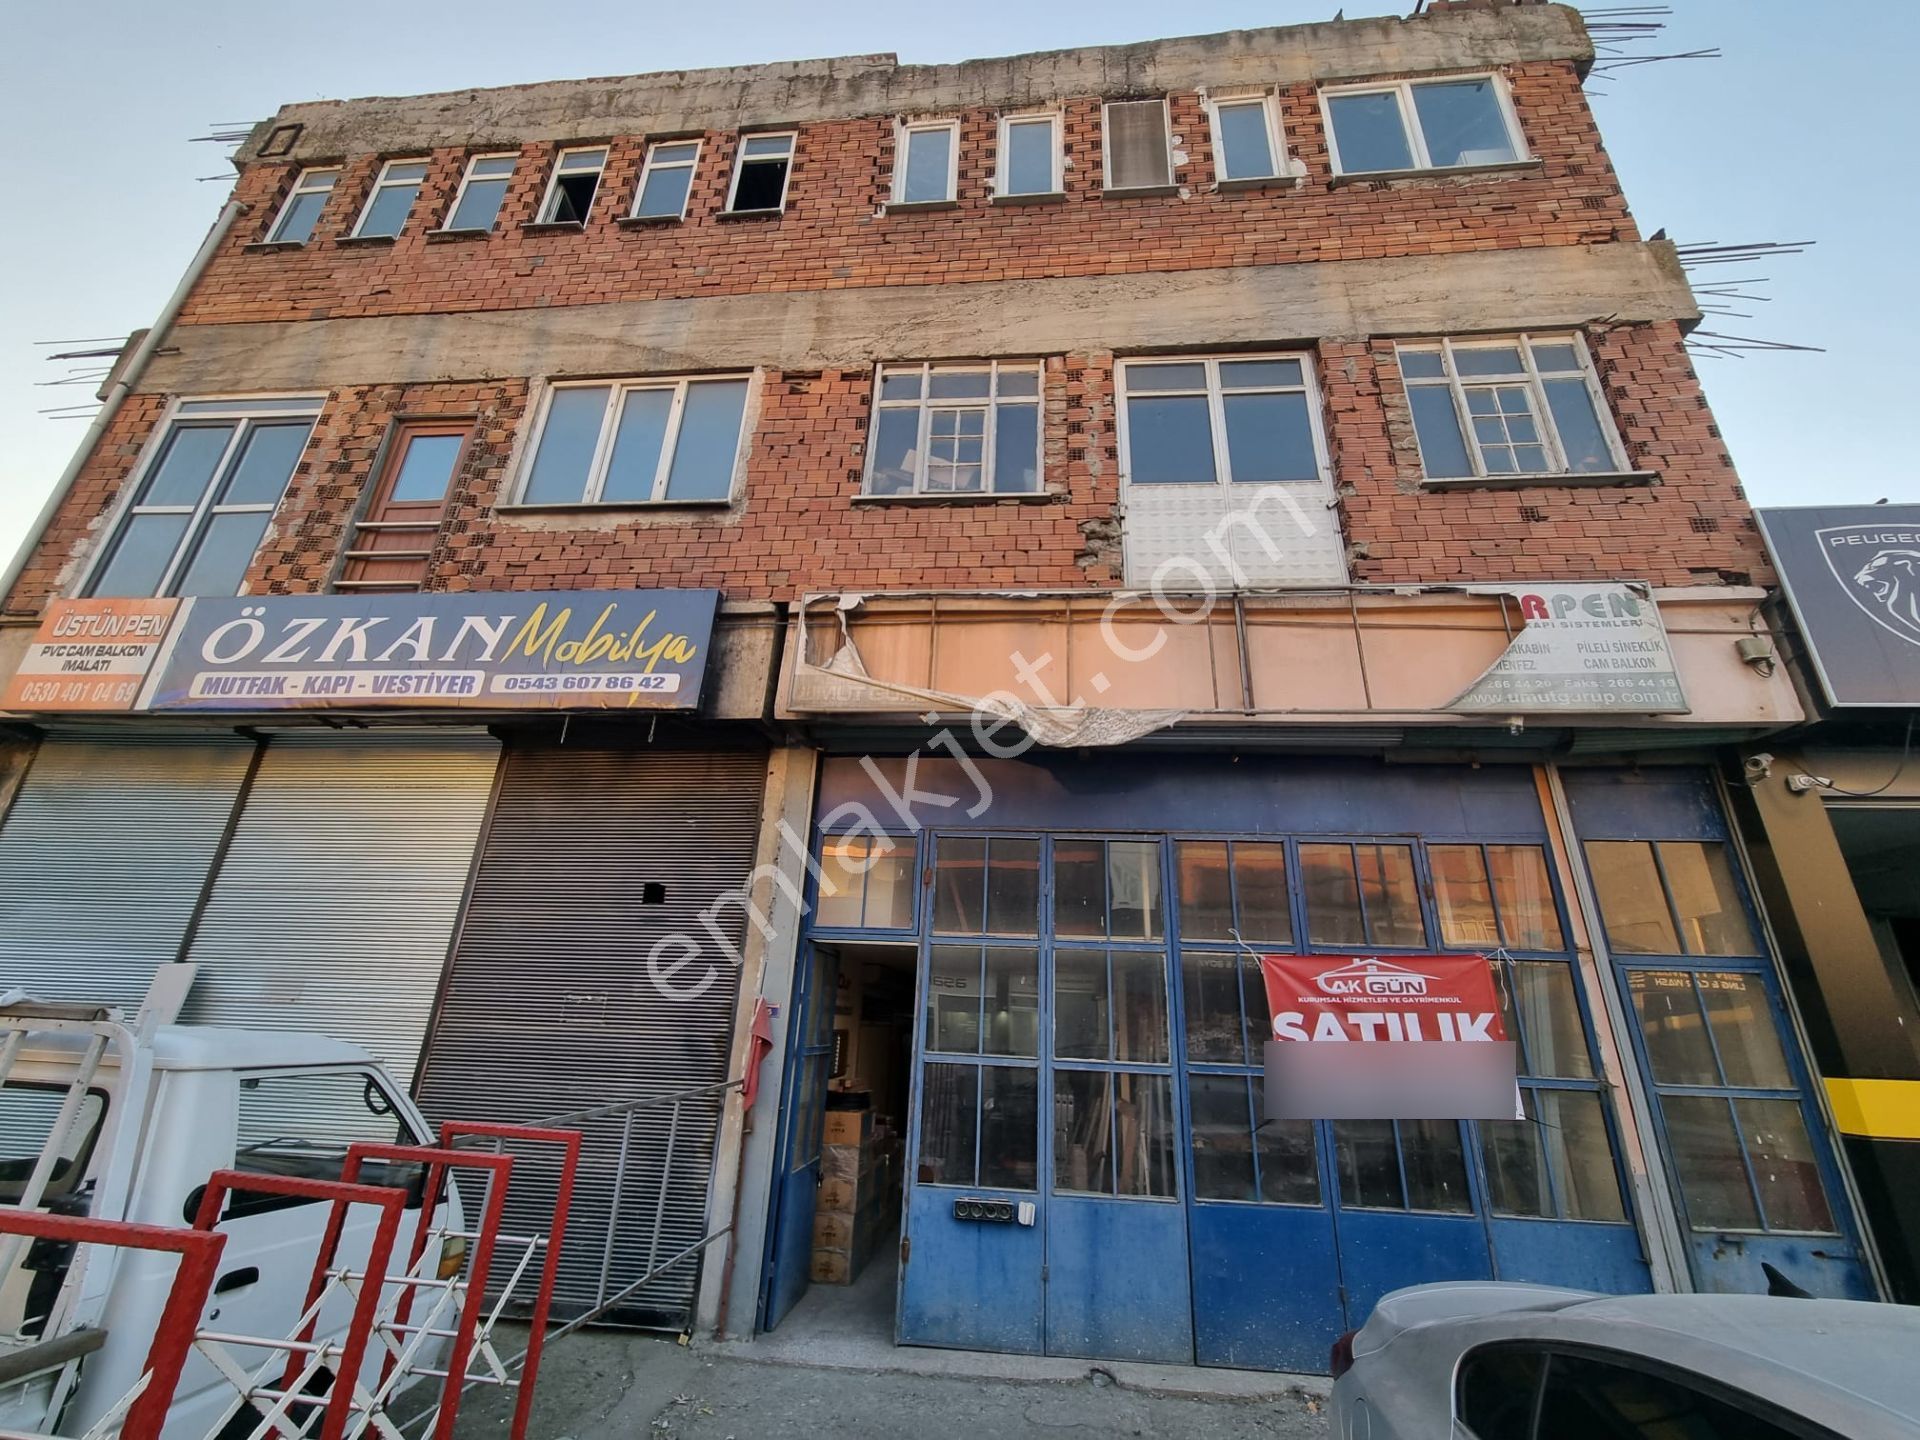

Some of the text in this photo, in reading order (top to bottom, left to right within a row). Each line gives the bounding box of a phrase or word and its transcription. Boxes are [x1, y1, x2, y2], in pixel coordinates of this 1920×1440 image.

[52, 608, 169, 637] ÜSTÜN PEN
[201, 606, 516, 665] ÖZKAN
[40, 645, 148, 657] PVC CAM BALKON
[1577, 638, 1665, 653] PİLELİ SİNEKLİK
[500, 601, 698, 708] Mobilya
[1584, 657, 1657, 670] CAM BALKON
[200, 675, 288, 696] MUTFAK
[302, 675, 354, 694] KAPI
[372, 671, 476, 694] VESTİYER
[504, 676, 666, 691] 0543 607 86 42
[1638, 679, 1655, 687] 44
[20, 681, 139, 702] 0530 401 04 69
[1369, 978, 1424, 993] GÜN
[1298, 996, 1344, 1004] KURUMSAL
[1344, 995, 1388, 1003] HİZMETLER
[1402, 995, 1462, 1003] GAYRİMENKUL
